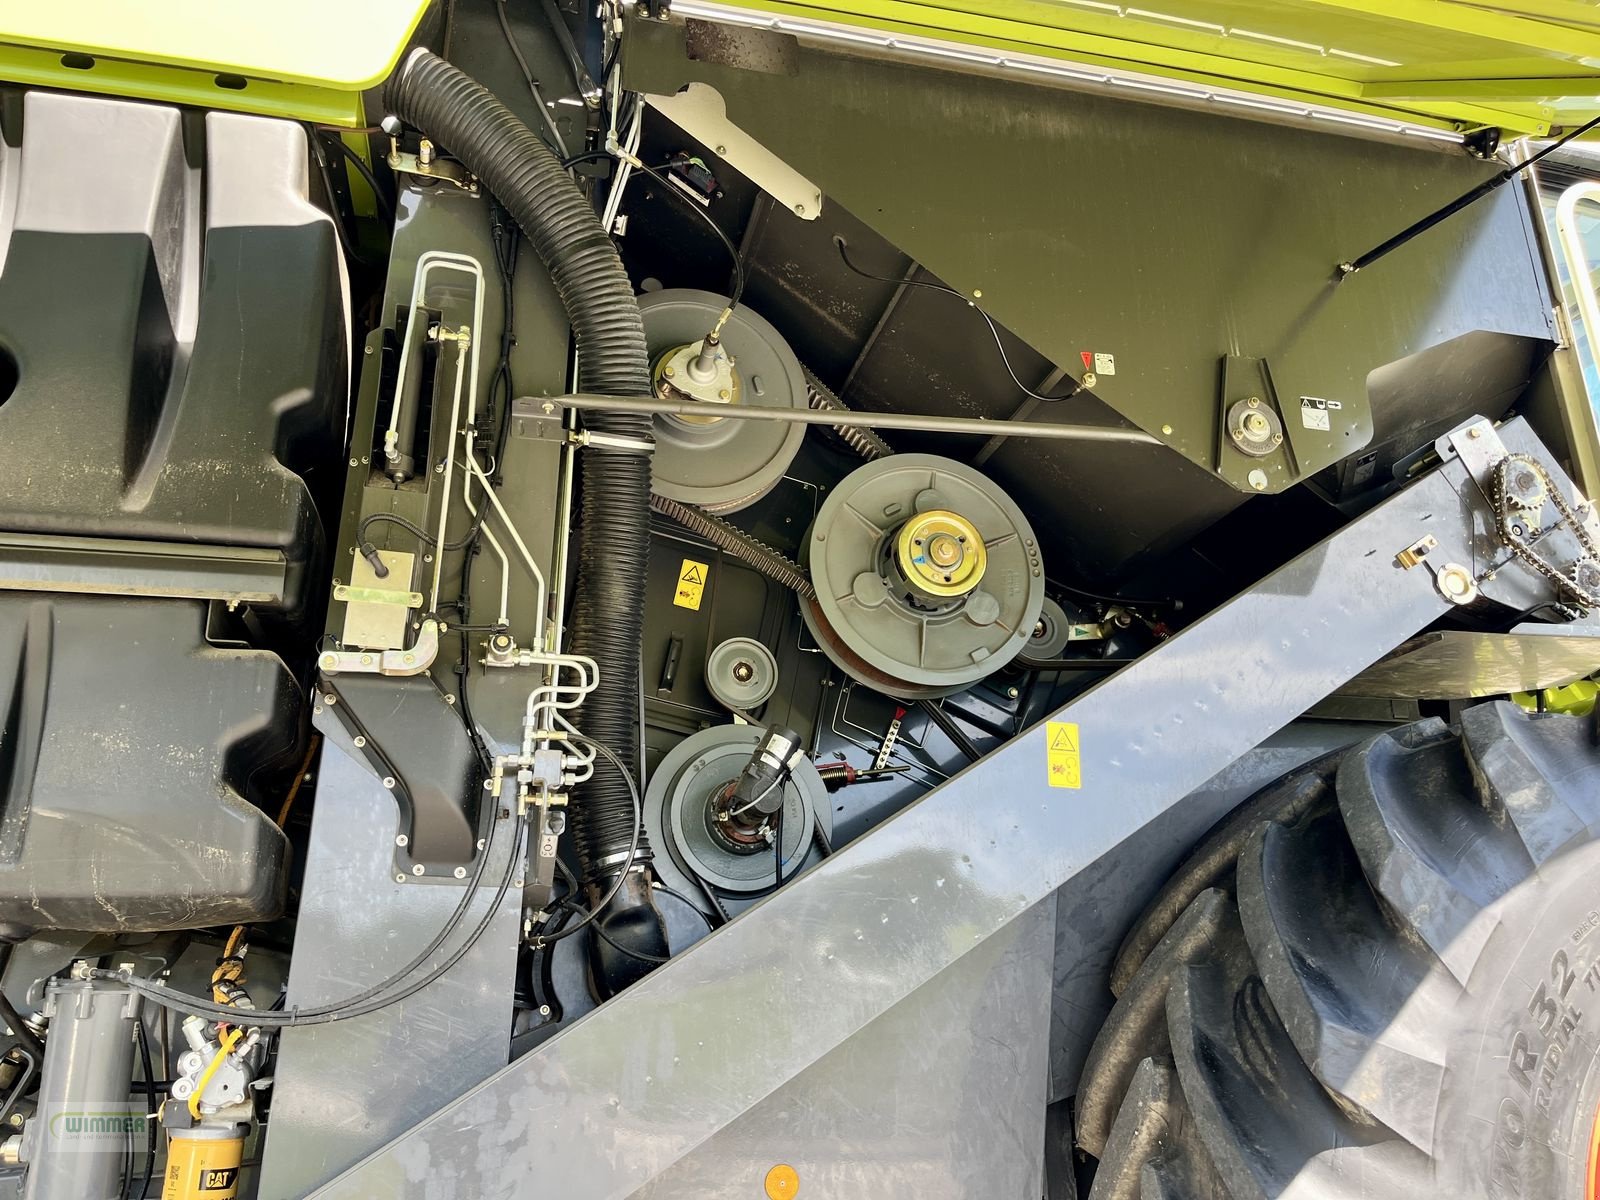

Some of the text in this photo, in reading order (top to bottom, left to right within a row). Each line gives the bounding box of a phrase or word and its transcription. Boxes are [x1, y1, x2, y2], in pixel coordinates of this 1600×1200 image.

[1507, 1030, 1541, 1098] R
[1528, 949, 1577, 1038] 32
[1534, 1002, 1583, 1120] RADIAL
[206, 1172, 229, 1188] CAT
